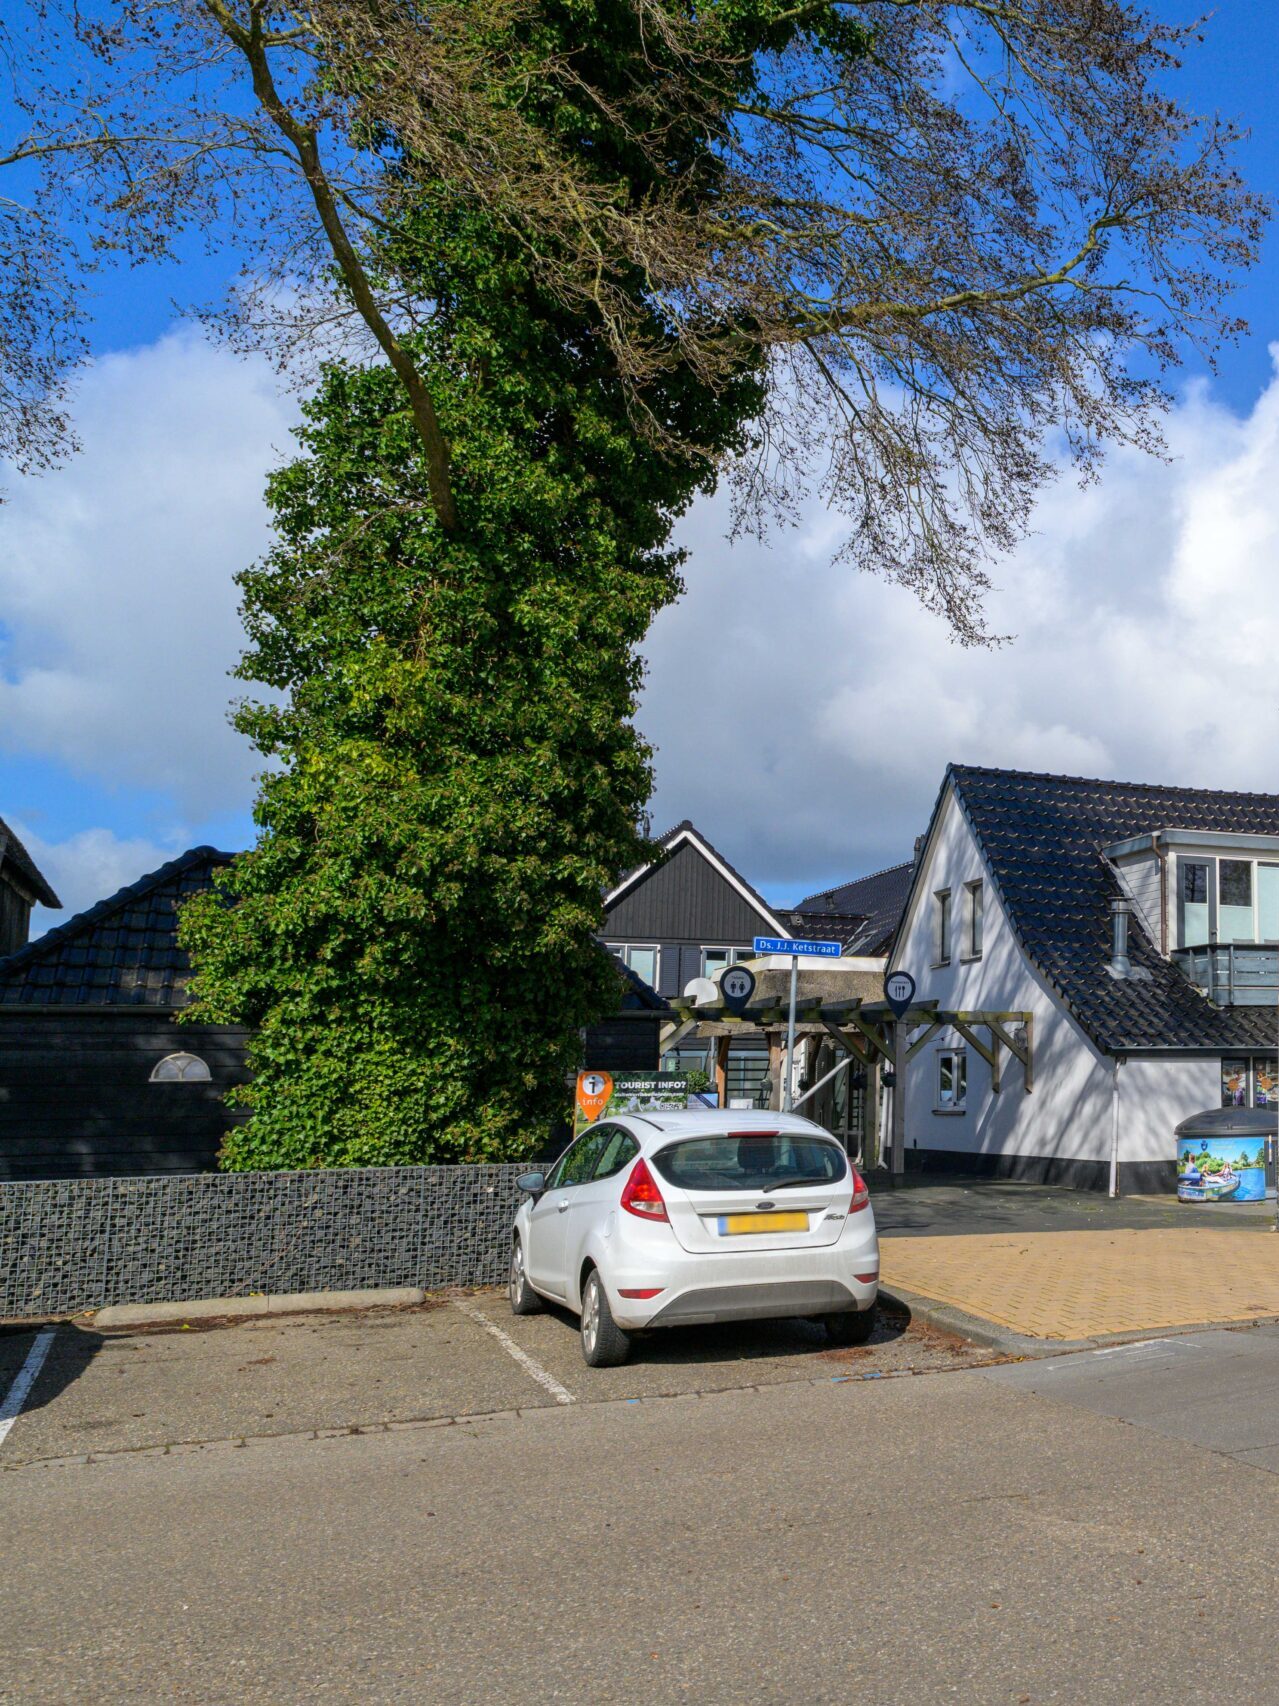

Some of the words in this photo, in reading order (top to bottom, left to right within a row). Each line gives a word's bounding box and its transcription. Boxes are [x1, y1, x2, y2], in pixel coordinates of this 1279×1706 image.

[760, 940, 773, 949] Ds.
[776, 942, 790, 951] J.J.
[792, 943, 836, 954] Ketstraat
[614, 1081, 657, 1090] TOURIST
[658, 1081, 687, 1089] INFO?
[582, 1097, 604, 1106] info
